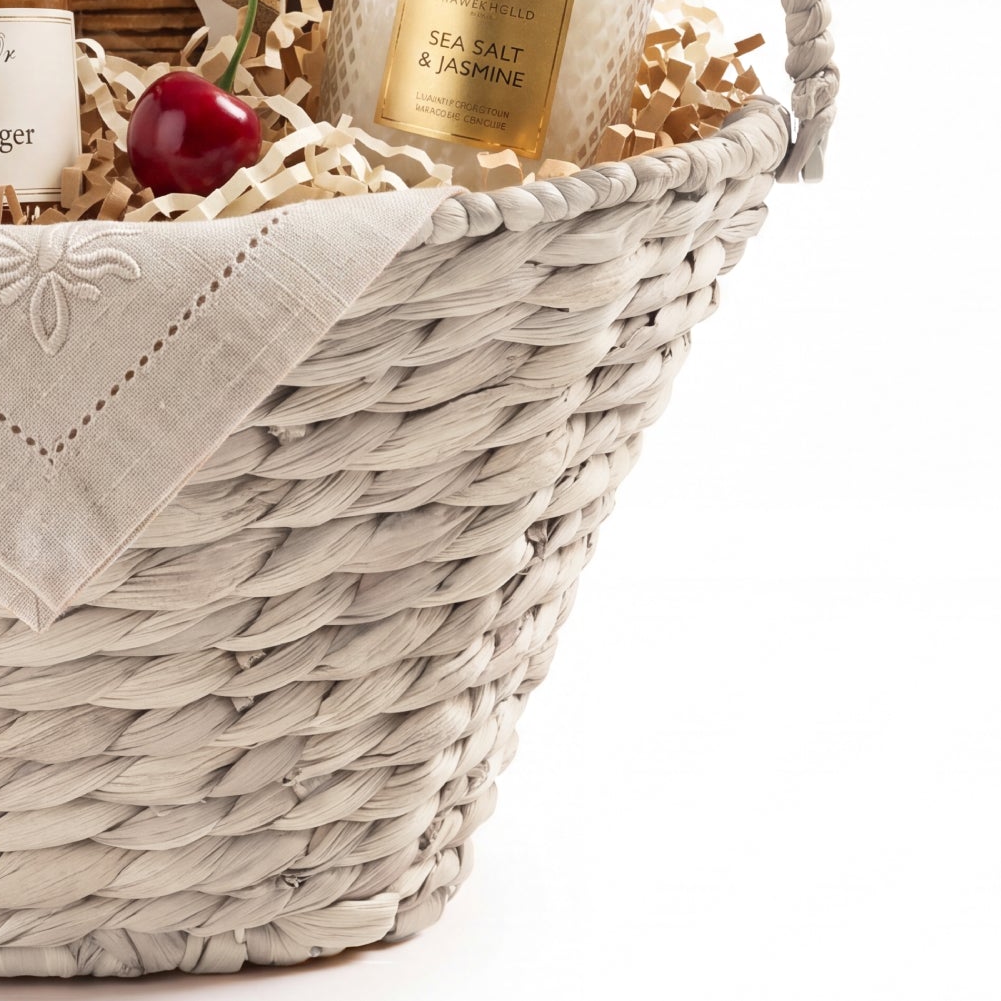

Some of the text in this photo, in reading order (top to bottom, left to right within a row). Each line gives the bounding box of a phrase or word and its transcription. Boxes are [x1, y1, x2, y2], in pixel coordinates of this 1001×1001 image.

[429, 30, 524, 64] SEA SALT
[418, 51, 525, 89] & JASMINE
